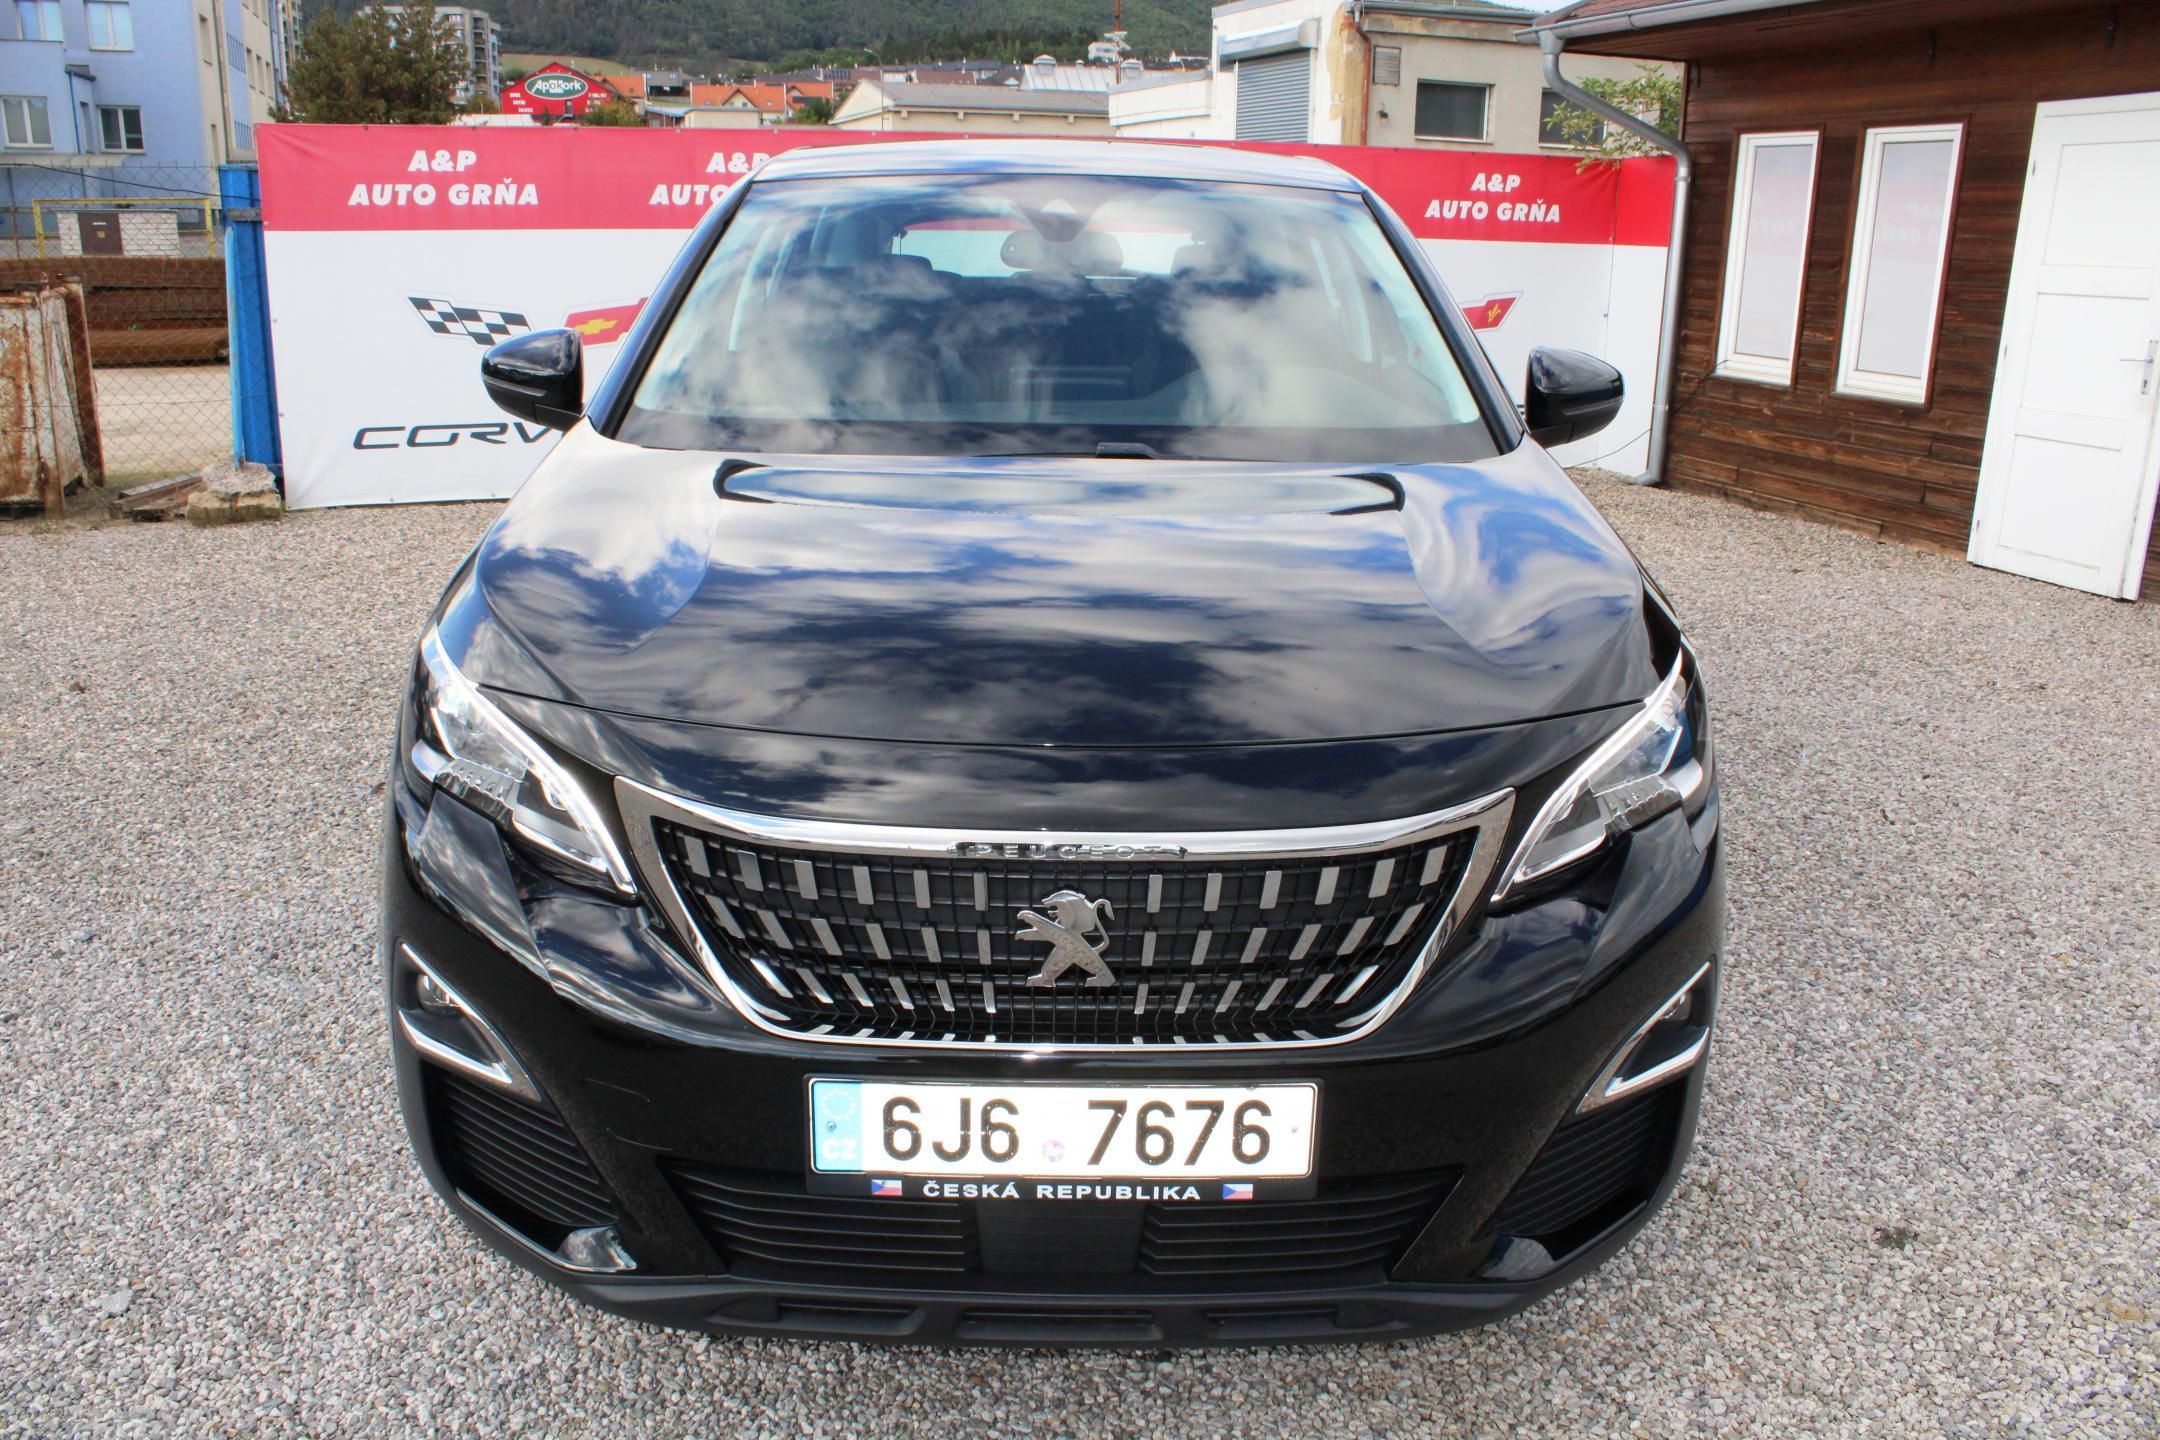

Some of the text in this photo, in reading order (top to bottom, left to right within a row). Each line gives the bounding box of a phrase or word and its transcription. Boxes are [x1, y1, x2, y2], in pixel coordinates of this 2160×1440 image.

[407, 149, 477, 172] A&P
[705, 152, 770, 173] A&P
[347, 177, 539, 206] AUTO GRŇA
[1470, 172, 1521, 193] A&P
[1424, 198, 1560, 223] AUTO GRŇA
[353, 422, 552, 450] CORV
[882, 1096, 1273, 1167] 6J6 7676
[821, 1138, 857, 1161] CZ
[922, 1180, 1201, 1201] ČESKÁ REPUBLIKA
